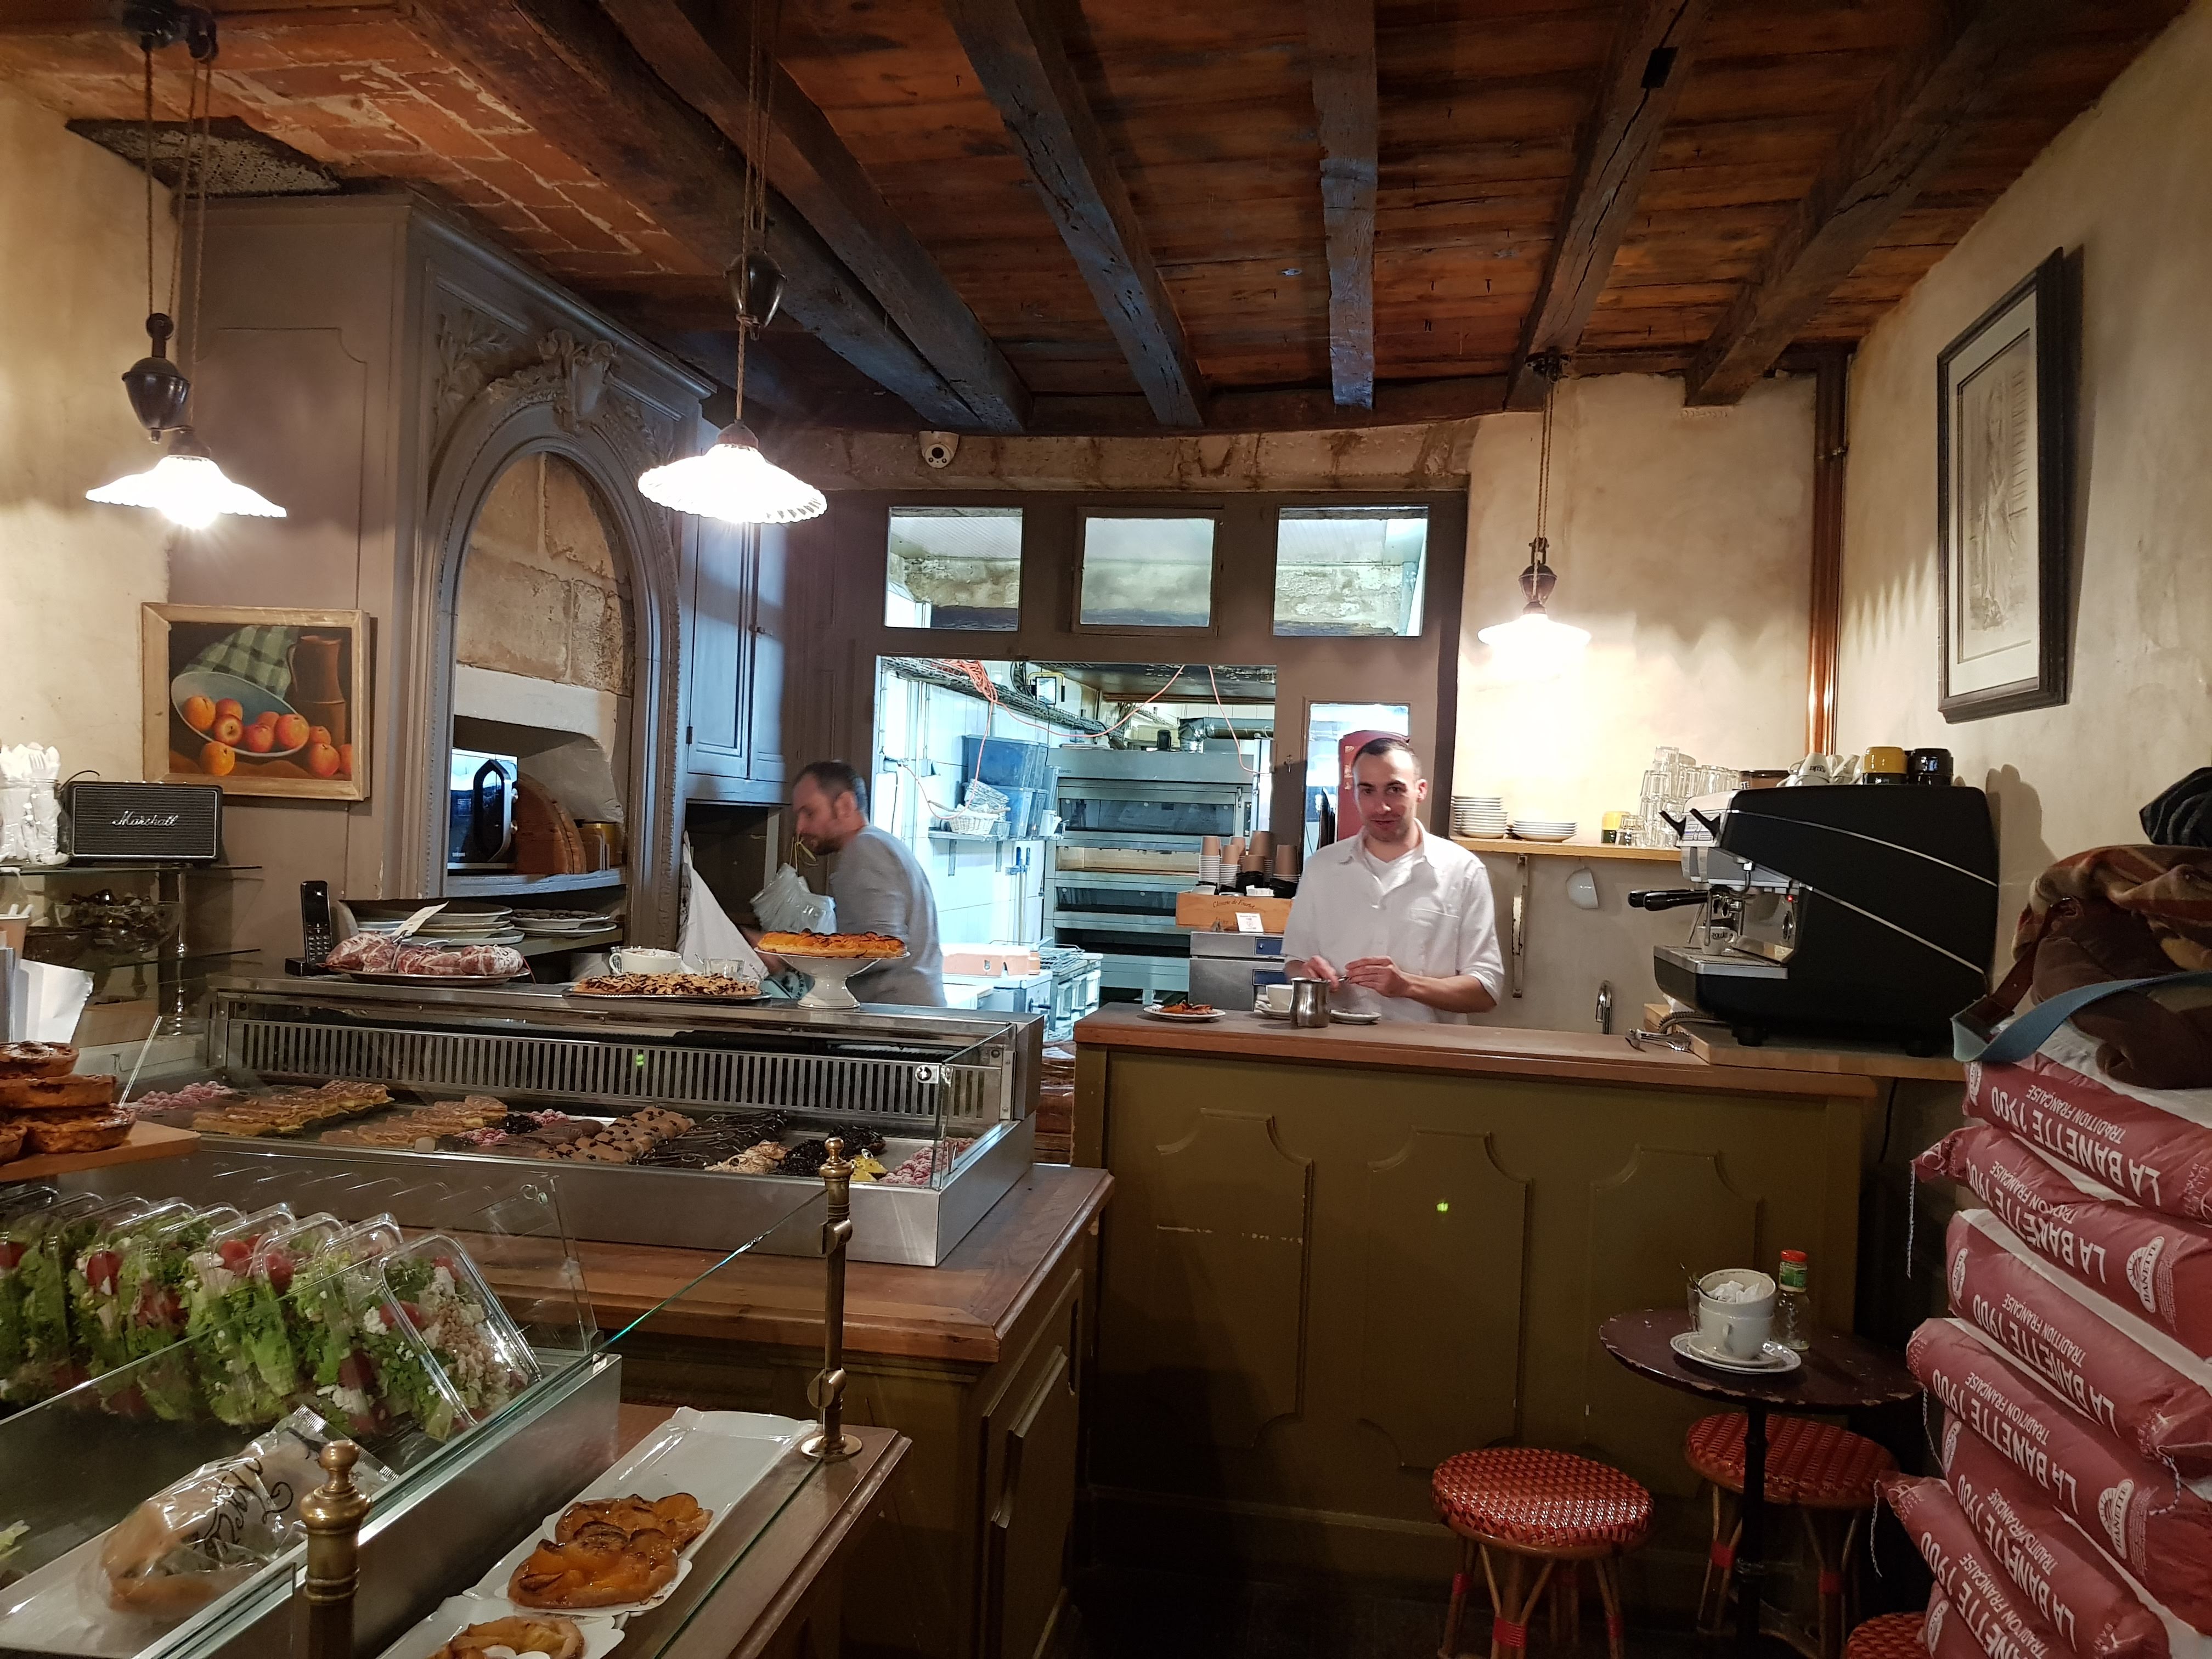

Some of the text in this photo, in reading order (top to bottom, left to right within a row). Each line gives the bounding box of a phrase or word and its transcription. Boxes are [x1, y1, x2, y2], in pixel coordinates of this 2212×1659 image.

[112, 810, 179, 826] Marshall
[1991, 1087, 2027, 1133] 1900
[2027, 1085, 2126, 1144] TRADITION FRANÇAISE
[2032, 1110, 2125, 1187] BANETTE
[1990, 1161, 2032, 1203] FRANÇAISE
[2129, 1158, 2160, 1207] LA
[1995, 1187, 2075, 1268] BANETTE
[2080, 1237, 2106, 1284] LA
[1973, 1295, 2007, 1342] 1900
[2002, 1294, 2086, 1368] TRADITION FRANÇAISE
[1933, 1369, 1966, 1420] 1900
[2010, 1321, 2091, 1413] BANETTE
[1965, 1372, 2050, 1446] TRADITION FRANÇAISE
[2090, 1386, 2121, 1438] LA
[1972, 1398, 2049, 1489] BANETTE
[2052, 1462, 2079, 1515] LA
[1921, 1532, 1956, 1596] 1900
[1957, 1475, 2078, 1652] LA BANETTE 1900
[1959, 1553, 2008, 1613] FRANÇAISE
